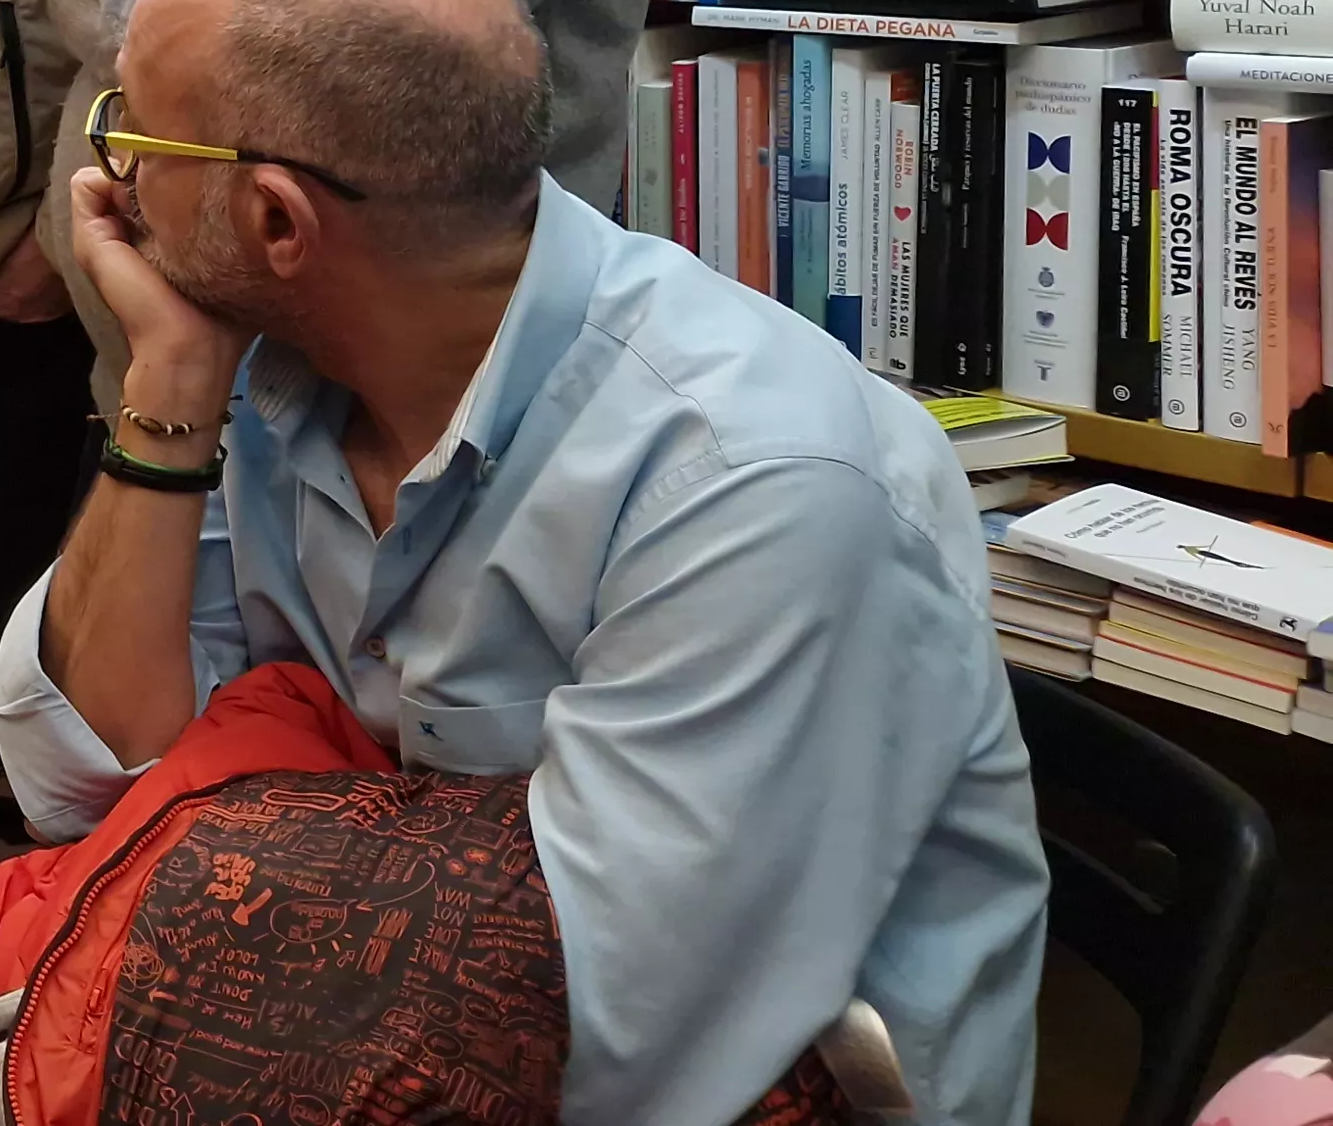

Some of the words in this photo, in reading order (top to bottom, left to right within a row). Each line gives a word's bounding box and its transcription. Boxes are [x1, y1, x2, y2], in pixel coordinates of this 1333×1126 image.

[787, 15, 813, 31] LA
[816, 16, 870, 35] DIETA
[874, 19, 956, 40] PEGANA
[1224, 17, 1290, 36] Harari
[929, 63, 940, 75] LA
[1020, 76, 1086, 90] Diccionario
[800, 59, 816, 113] ahogadas
[929, 76, 940, 109] PUERTA
[1117, 97, 1138, 108] 117
[840, 90, 850, 124] CLEAR
[1025, 102, 1036, 112] de
[1040, 104, 1077, 115] dudas
[799, 115, 812, 170] Memorias
[928, 110, 940, 151] CERRADA
[1132, 122, 1141, 134] EL
[1236, 117, 1257, 138] EL
[840, 128, 850, 161] JAMES
[893, 128, 904, 190] NORWOOD
[904, 140, 914, 176] ROBIN
[1169, 108, 1192, 185] ROMA
[1131, 181, 1141, 193] EN
[1235, 146, 1257, 216] MUNDO
[836, 183, 850, 249] atómicos
[1130, 194, 1141, 228] ESPAÑA
[1169, 192, 1192, 298] OSCURA
[1235, 220, 1257, 244] AL
[892, 237, 900, 270] AMAN
[901, 241, 911, 260] LAS
[900, 264, 911, 312] MUJERES
[1234, 250, 1262, 311] REVÉS
[889, 274, 899, 339] DEMASIADO
[899, 315, 910, 339] QUE
[1162, 313, 1173, 377] SOMMER
[1180, 315, 1193, 378] MICHAEL
[1222, 323, 1236, 391] JISHENG
[1241, 327, 1255, 372] YANG
[434, 882, 471, 911] WAR
[433, 903, 467, 927] NOT
[423, 921, 461, 954] LOVE
[408, 938, 451, 974] MAKE
[210, 982, 253, 1001] DON'T
[222, 964, 266, 986] KNOW
[113, 1031, 178, 1083] GOOD
